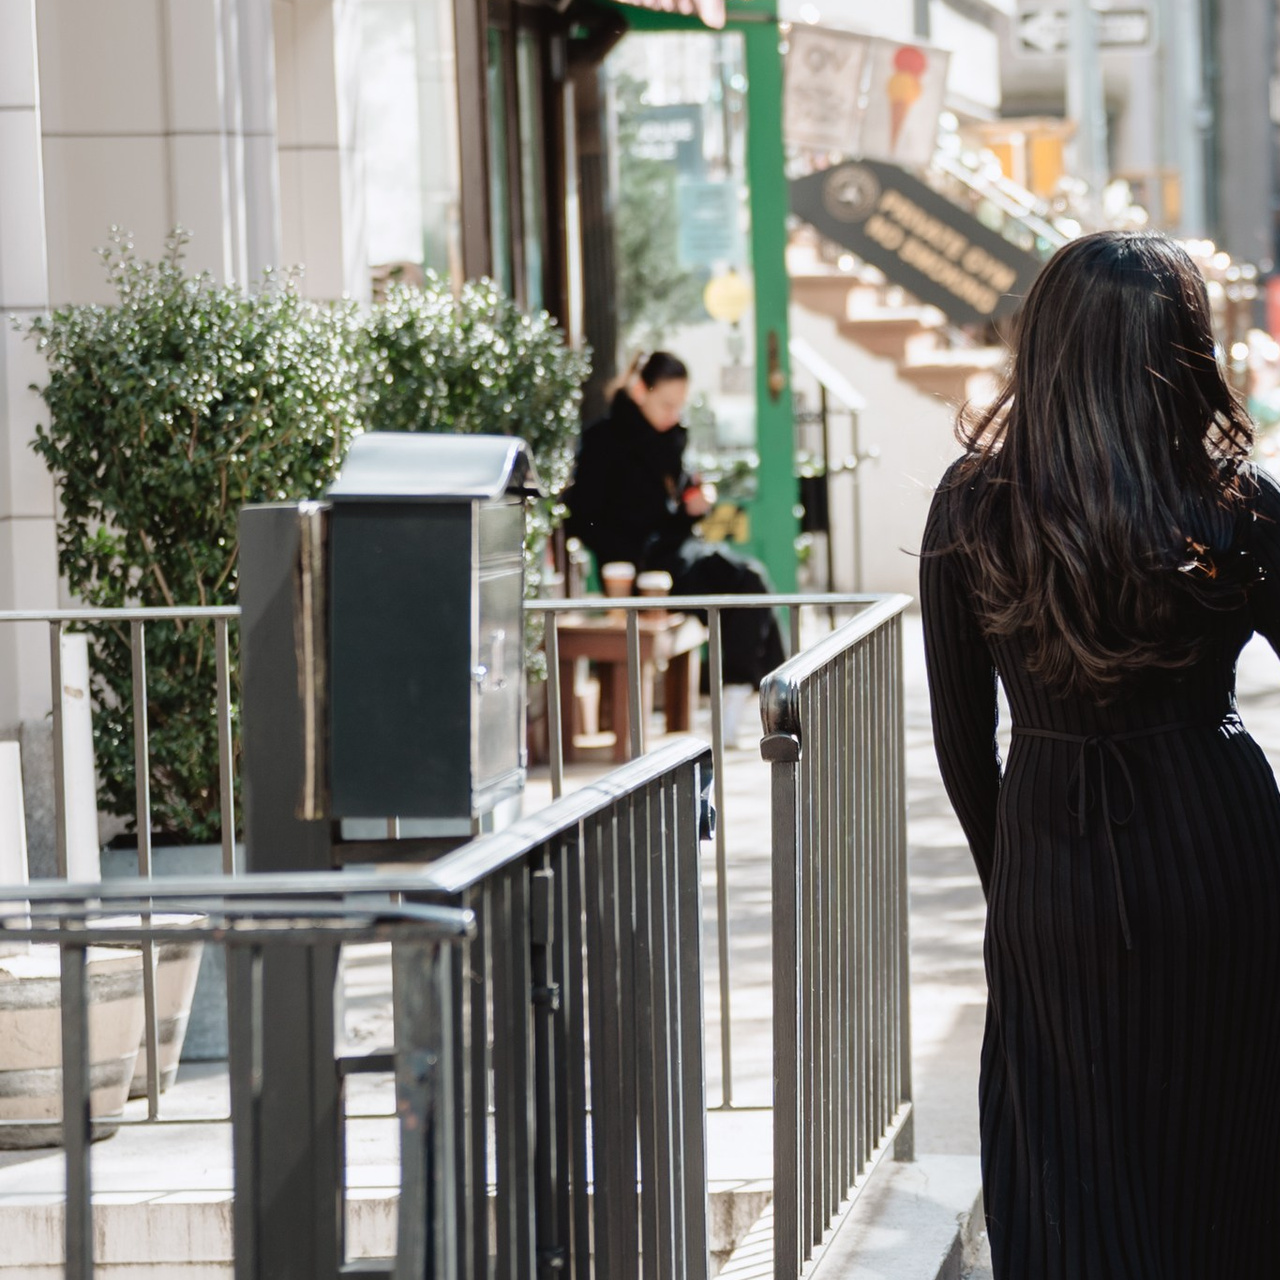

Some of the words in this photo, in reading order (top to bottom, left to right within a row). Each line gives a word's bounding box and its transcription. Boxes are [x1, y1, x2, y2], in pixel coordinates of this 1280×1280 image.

[864, 214, 904, 252] NO
[898, 236, 1000, 315] SMOKING
[879, 188, 969, 263] PRIVATE
[961, 244, 1018, 294] GYM
